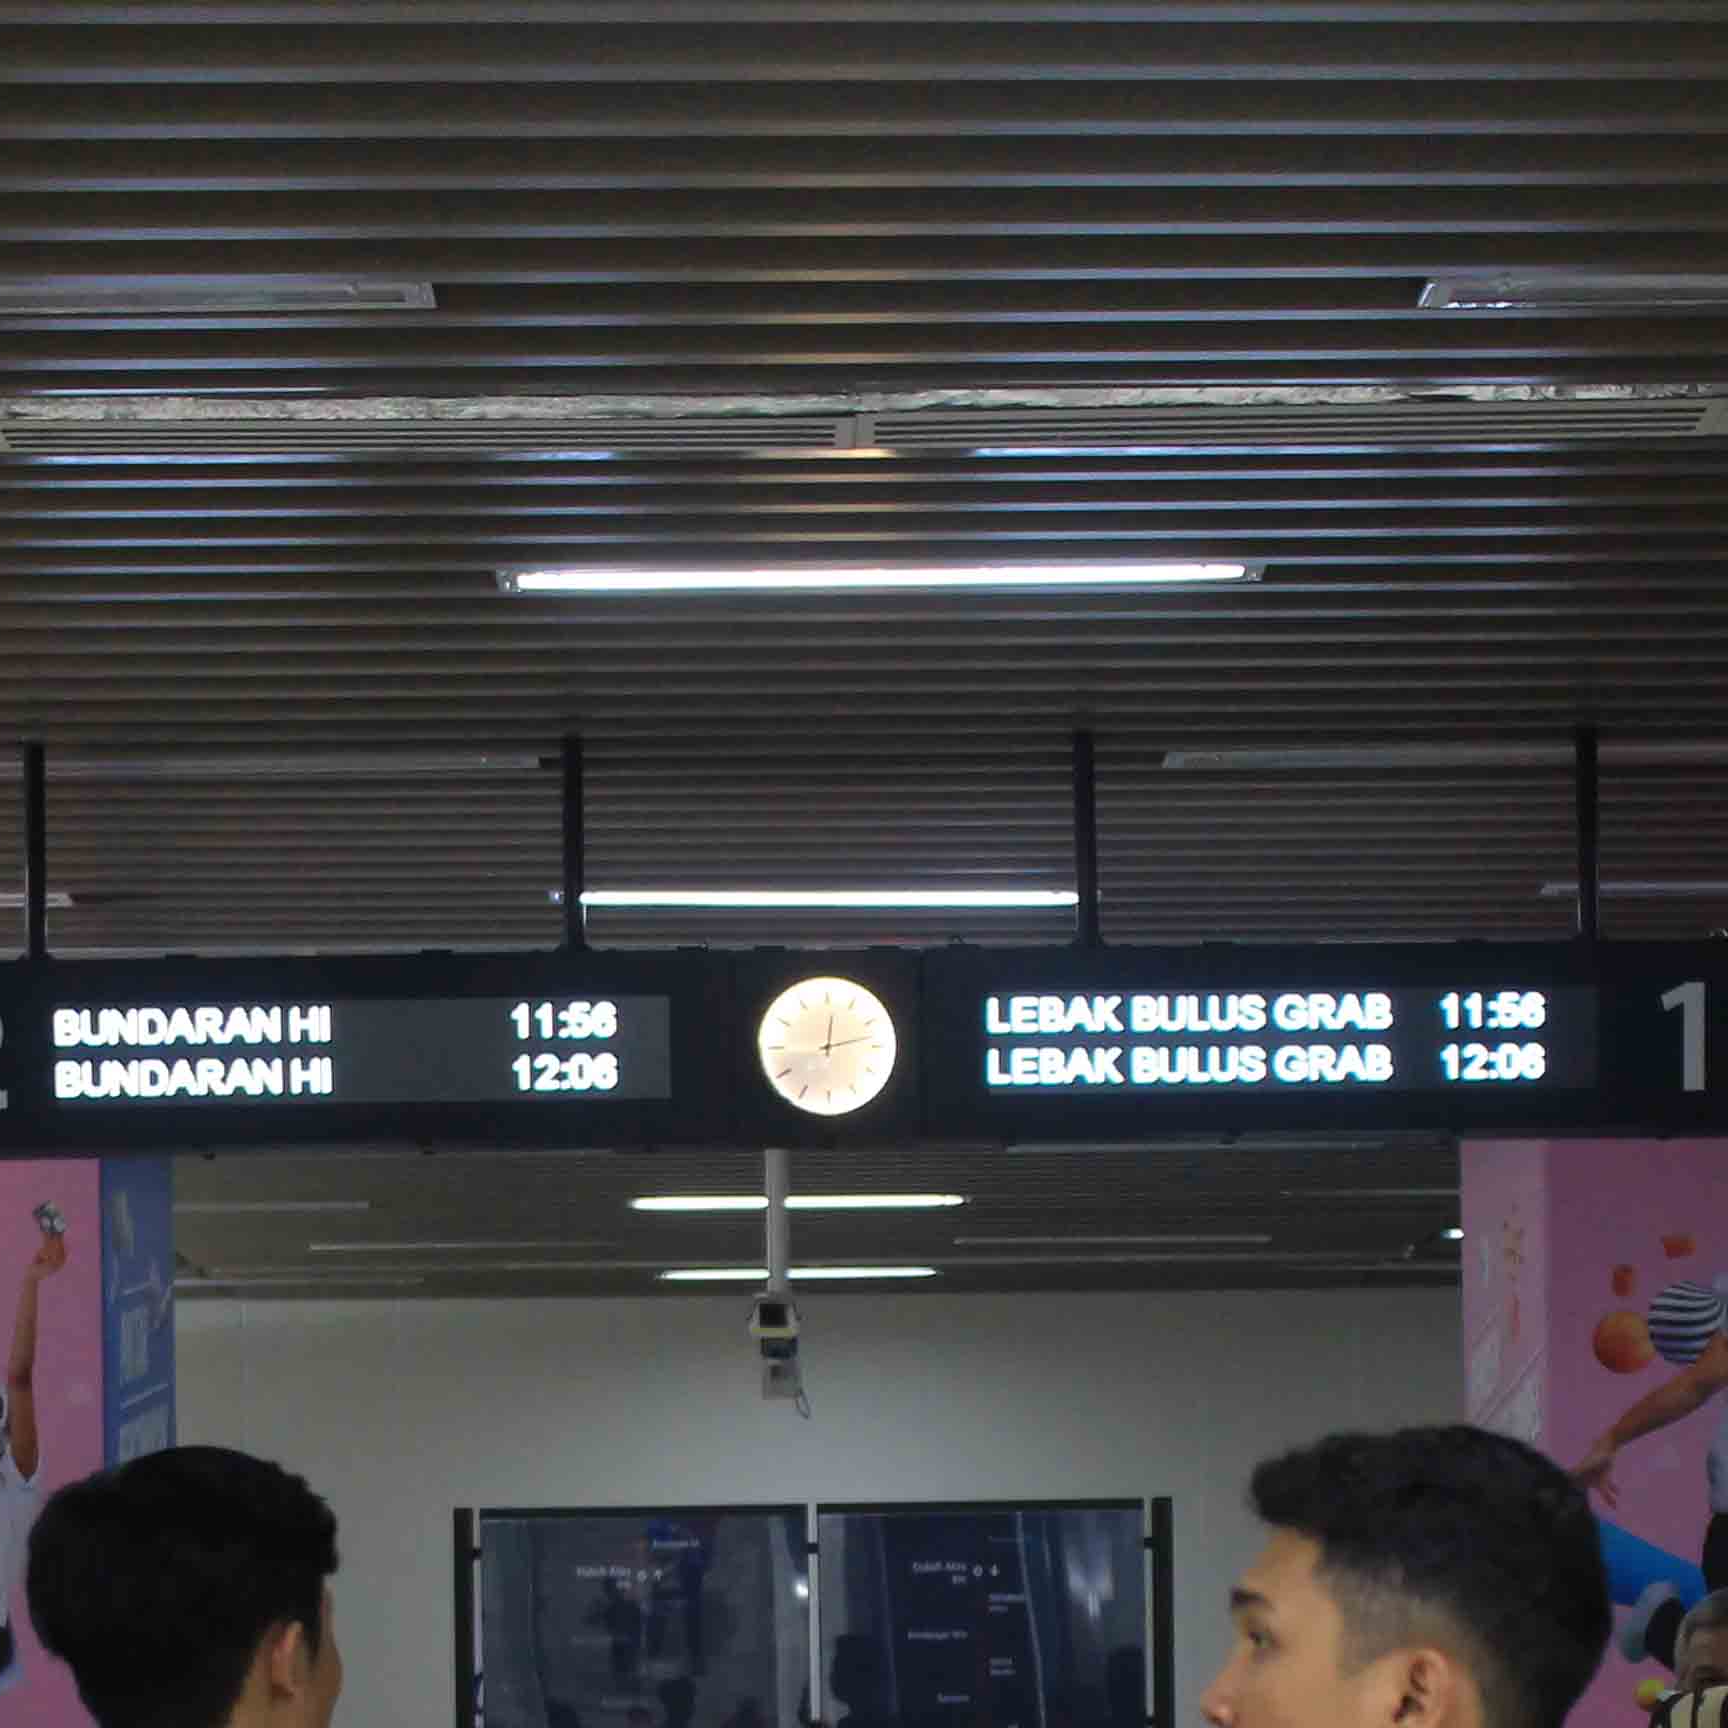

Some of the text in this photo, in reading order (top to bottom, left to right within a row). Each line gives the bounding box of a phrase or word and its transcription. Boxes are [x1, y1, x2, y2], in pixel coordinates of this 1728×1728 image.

[52, 1005, 332, 1047] BUNDARAN HI
[511, 1001, 617, 1039] 11:56
[986, 993, 1394, 1033] LEBAK BULUS GRAB
[1440, 991, 1546, 1030] 11:56
[1662, 982, 1705, 1091] 1
[54, 1057, 333, 1098] BUNDARAN HI
[512, 1053, 618, 1090] 12:06
[986, 1044, 1394, 1084] LEBAK BULUS GRAB
[1440, 1042, 1546, 1081] 12:06
